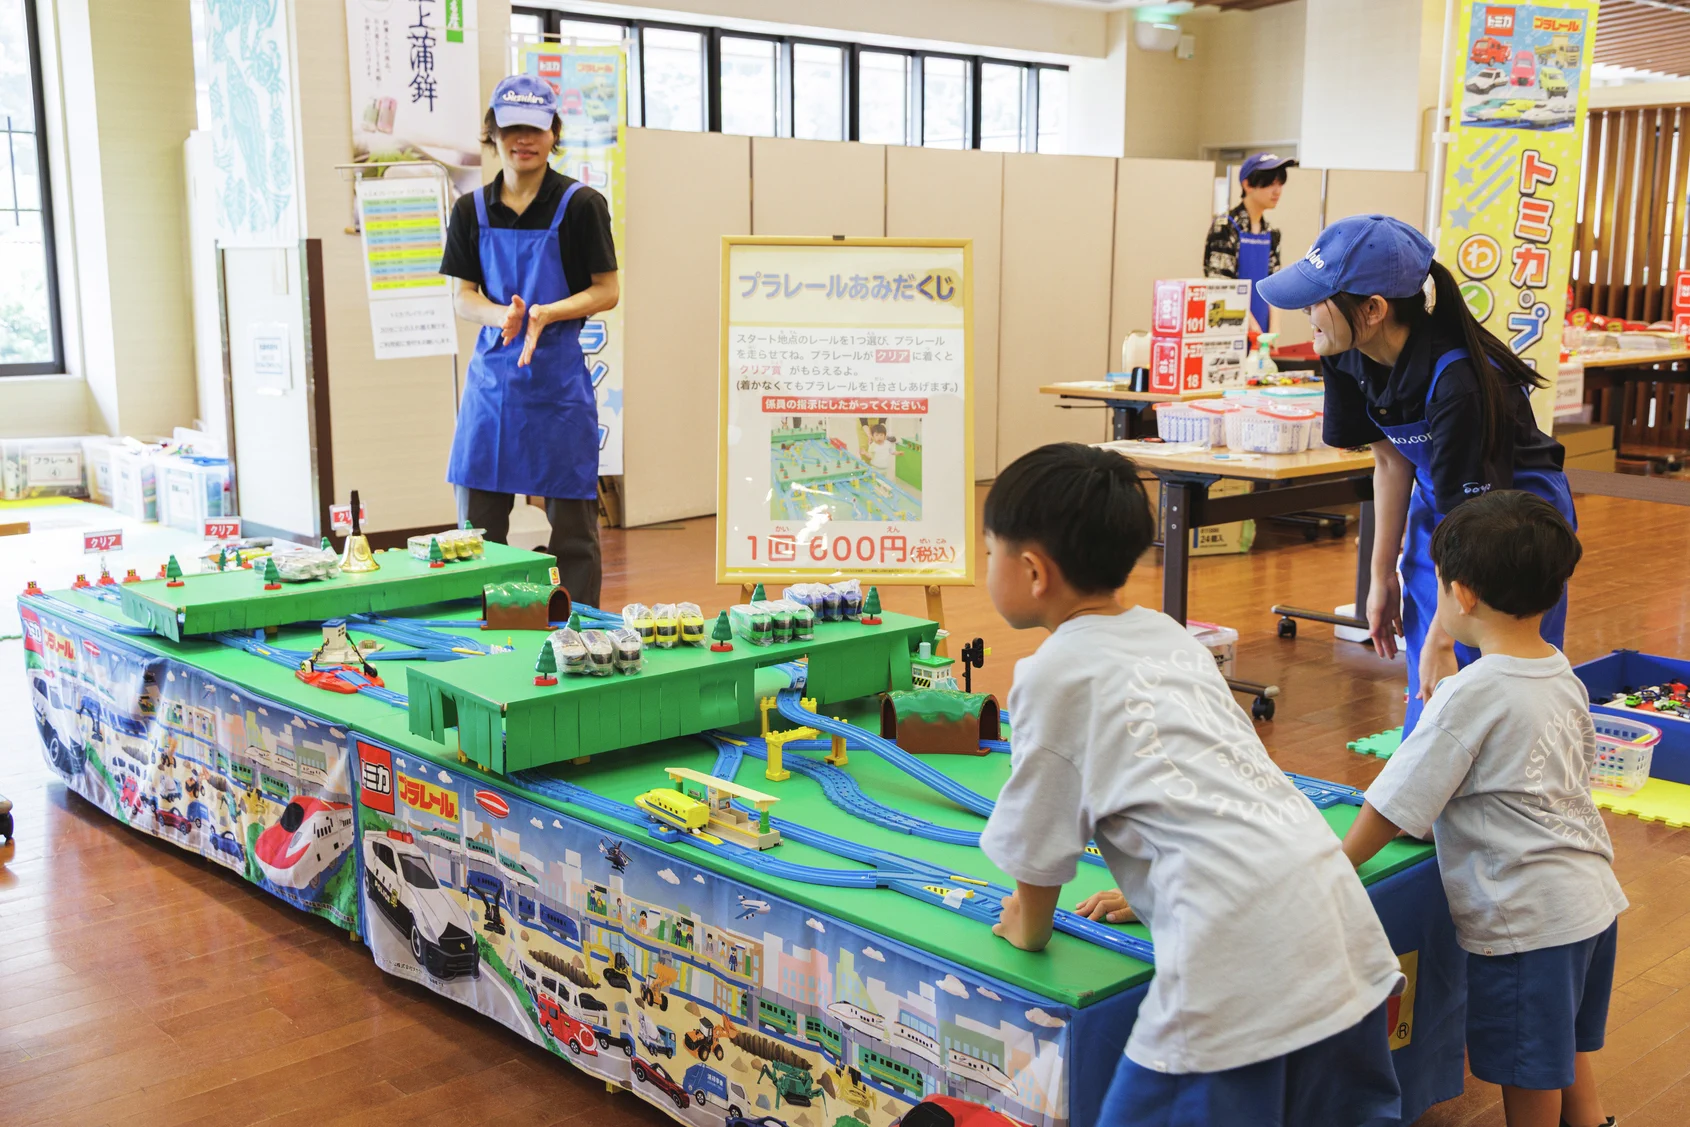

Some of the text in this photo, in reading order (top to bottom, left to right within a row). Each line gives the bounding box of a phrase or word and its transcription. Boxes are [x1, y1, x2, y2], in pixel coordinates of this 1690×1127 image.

[1487, 15, 1513, 28] トミカ
[1533, 17, 1580, 32] プラレール
[407, 0, 438, 112] 上蒲鉾
[1508, 149, 1557, 394] トミカ・プ
[738, 271, 955, 300] プラレールあみだくじ
[1186, 317, 1205, 332] 101
[877, 350, 909, 362] クリア
[912, 351, 954, 361] に着くと
[739, 364, 859, 376] クリア賞 がもらえるよ。
[1185, 373, 1200, 388] 18
[765, 398, 926, 410] 係員の指示にしたがってください。
[209, 524, 235, 535] クリア
[90, 536, 117, 548] クリア
[397, 775, 455, 819] プラレール
